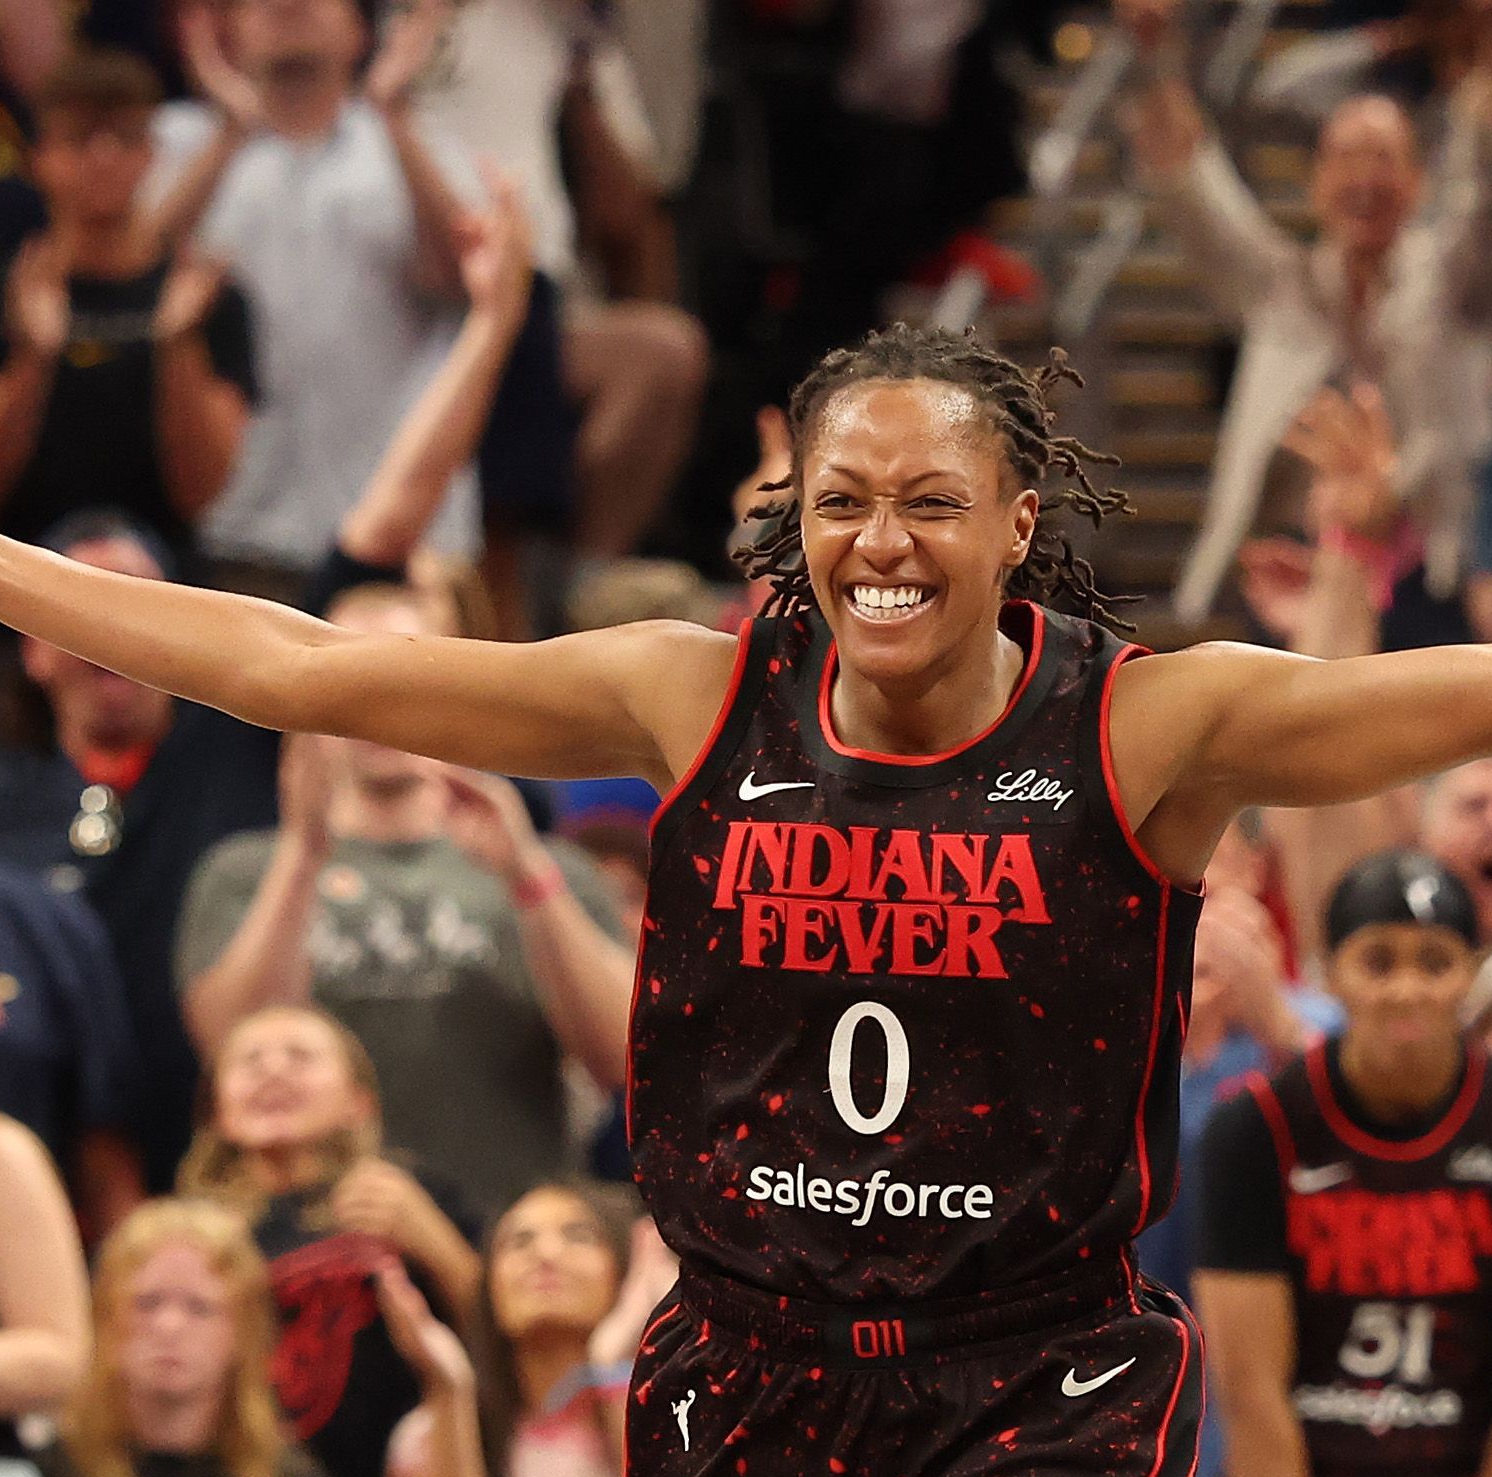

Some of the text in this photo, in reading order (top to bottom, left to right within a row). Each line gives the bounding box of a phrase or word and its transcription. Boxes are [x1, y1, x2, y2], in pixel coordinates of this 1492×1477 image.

[987, 768, 1074, 811] Lilly
[712, 821, 1053, 925] INDIANA
[739, 893, 1010, 980] FEVER
[828, 1001, 910, 1135] 0
[745, 1162, 994, 1227] salesforce
